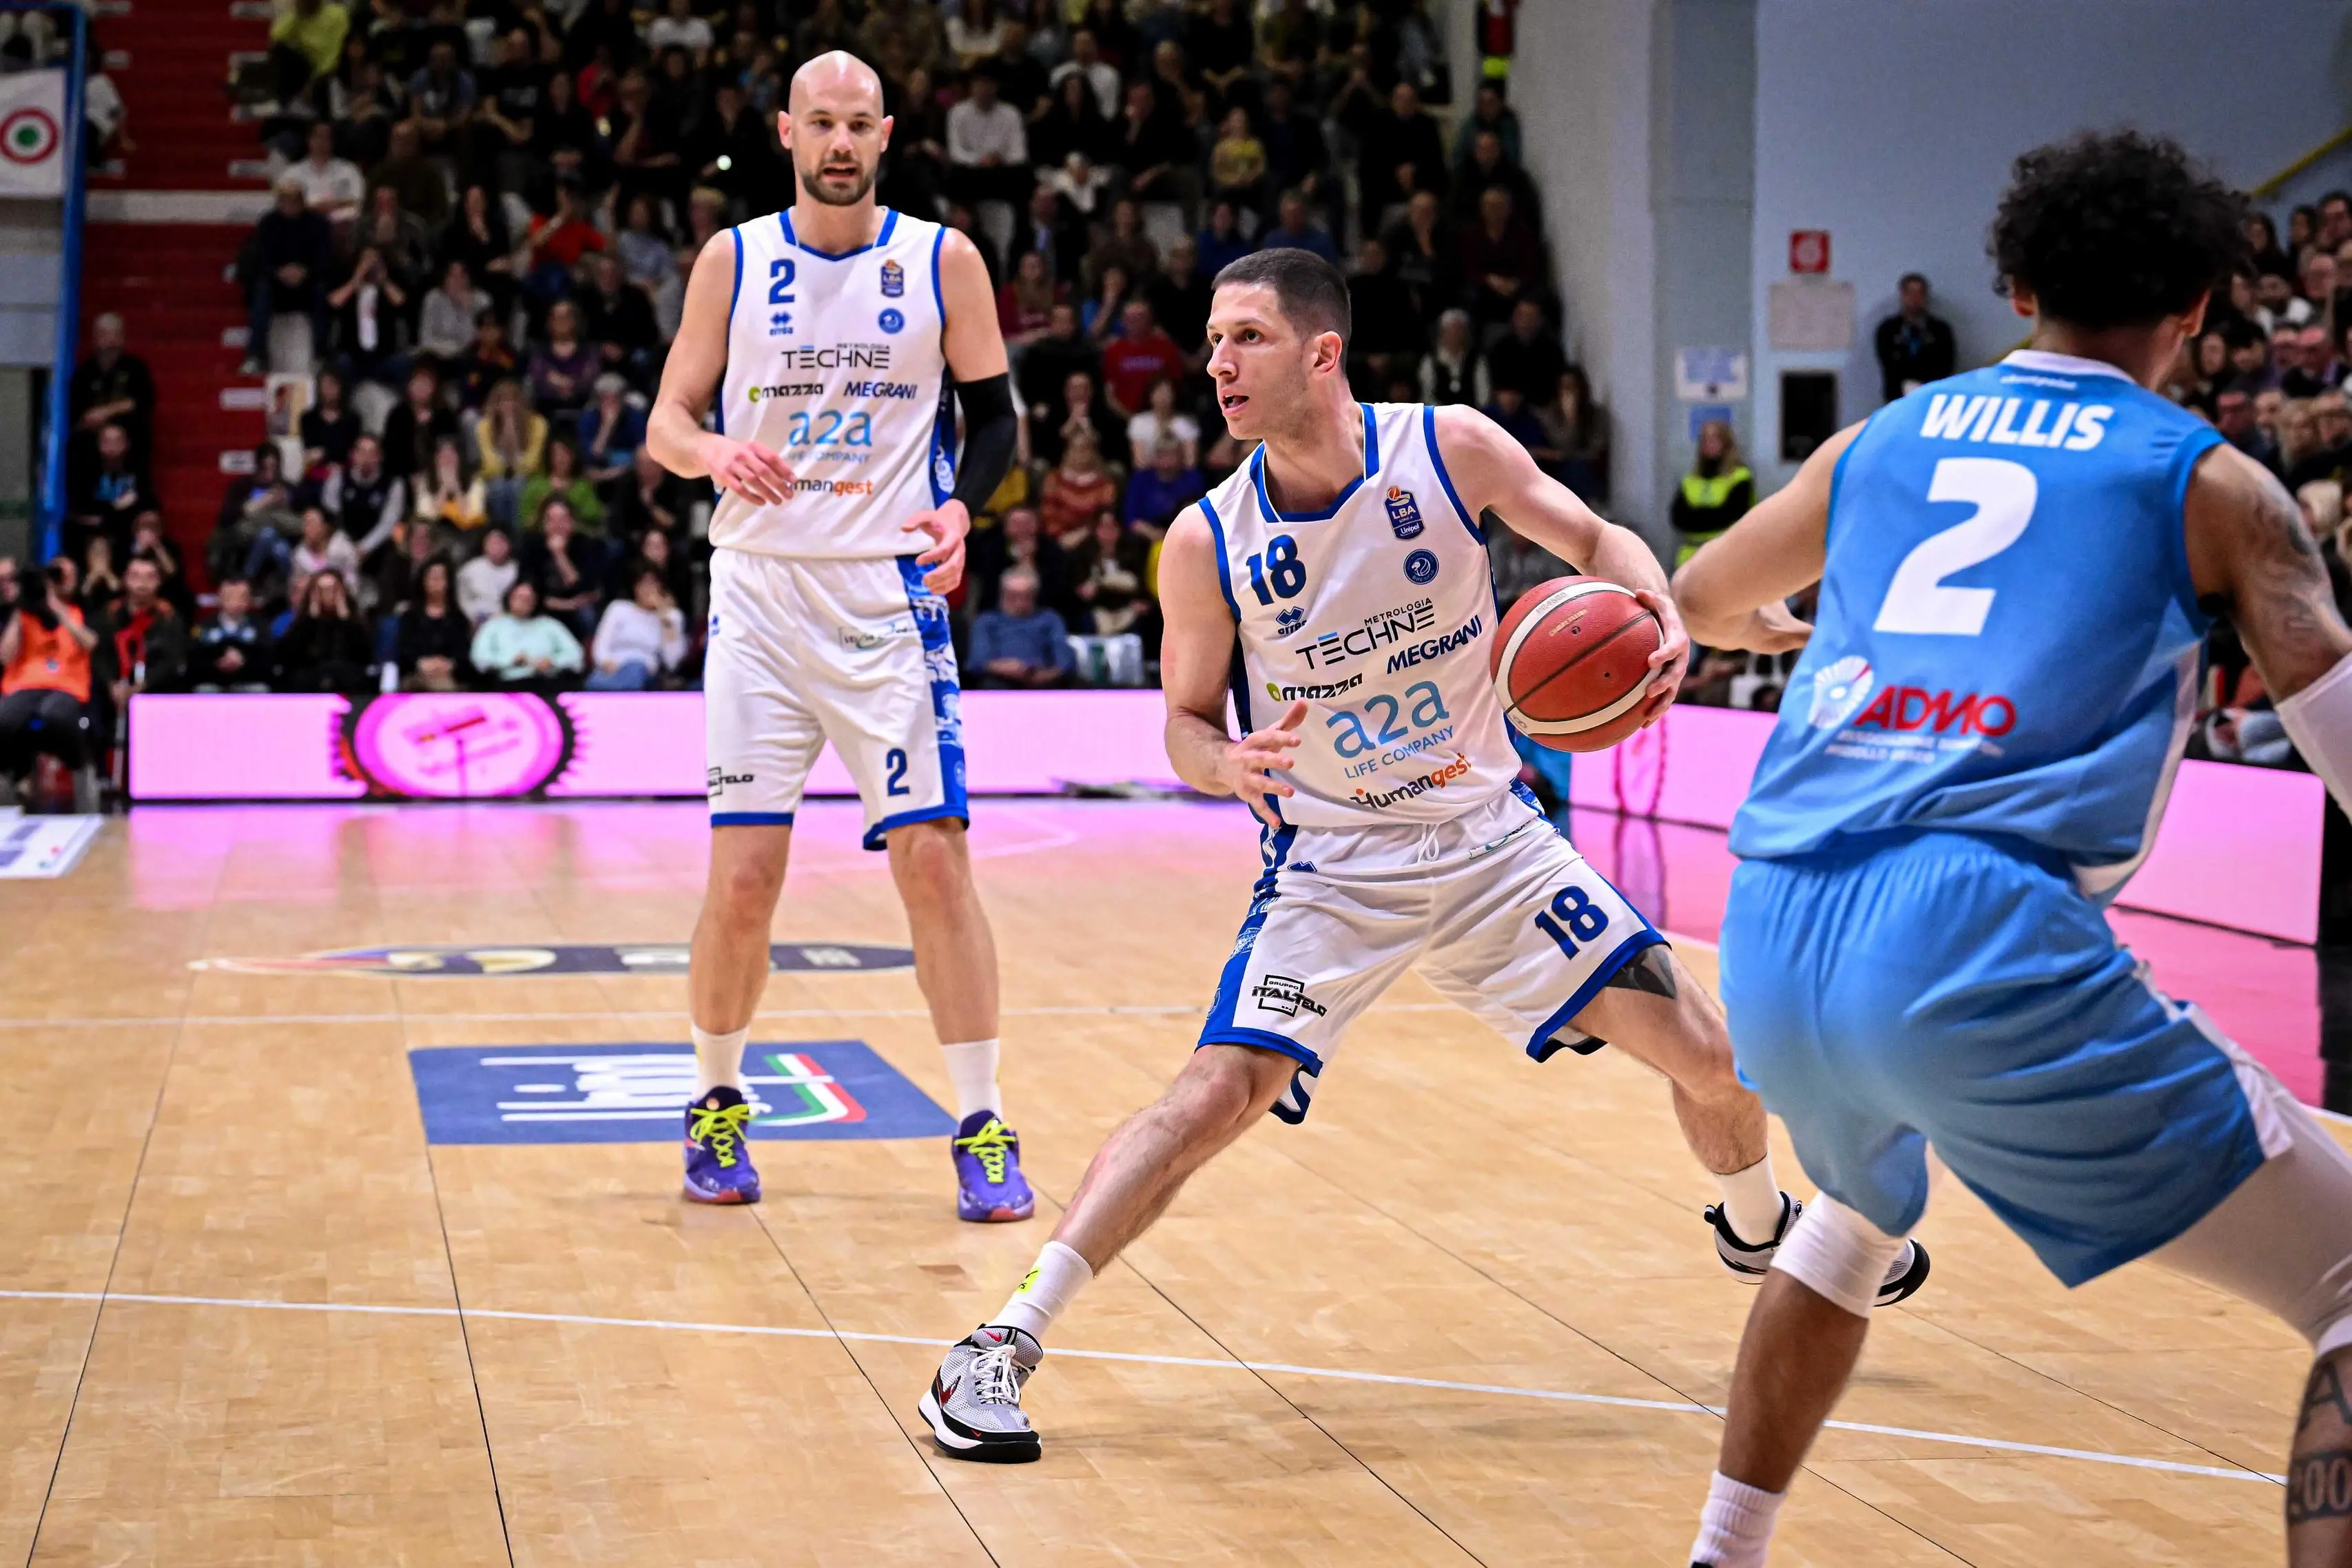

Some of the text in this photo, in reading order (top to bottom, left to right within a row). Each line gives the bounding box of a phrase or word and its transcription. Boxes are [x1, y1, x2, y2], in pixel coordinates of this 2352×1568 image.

[769, 259, 795, 304] 2
[782, 346, 889, 369] TECHNE
[843, 382, 918, 399] MEGRANI
[789, 409, 871, 447] a2a
[1920, 393, 2114, 451] WILLIS
[1392, 506, 1416, 519] LBA
[1401, 523, 1419, 534] Unipol
[1246, 535, 1306, 606] 18
[1873, 457, 2037, 635] 2
[1364, 597, 1432, 626] METROLOGIA
[1295, 604, 1435, 670] TECHNE
[1387, 615, 1483, 674] MEGRANI
[1282, 673, 1363, 701] mazza
[1853, 685, 2016, 737] ADMO
[1325, 681, 1450, 758] a2a
[886, 749, 910, 796] 2
[1344, 725, 1454, 778] LIFE COMPANY
[1350, 752, 1472, 809] Humangest
[1534, 886, 1609, 960] 18
[1269, 981, 1299, 990] GRUPPO
